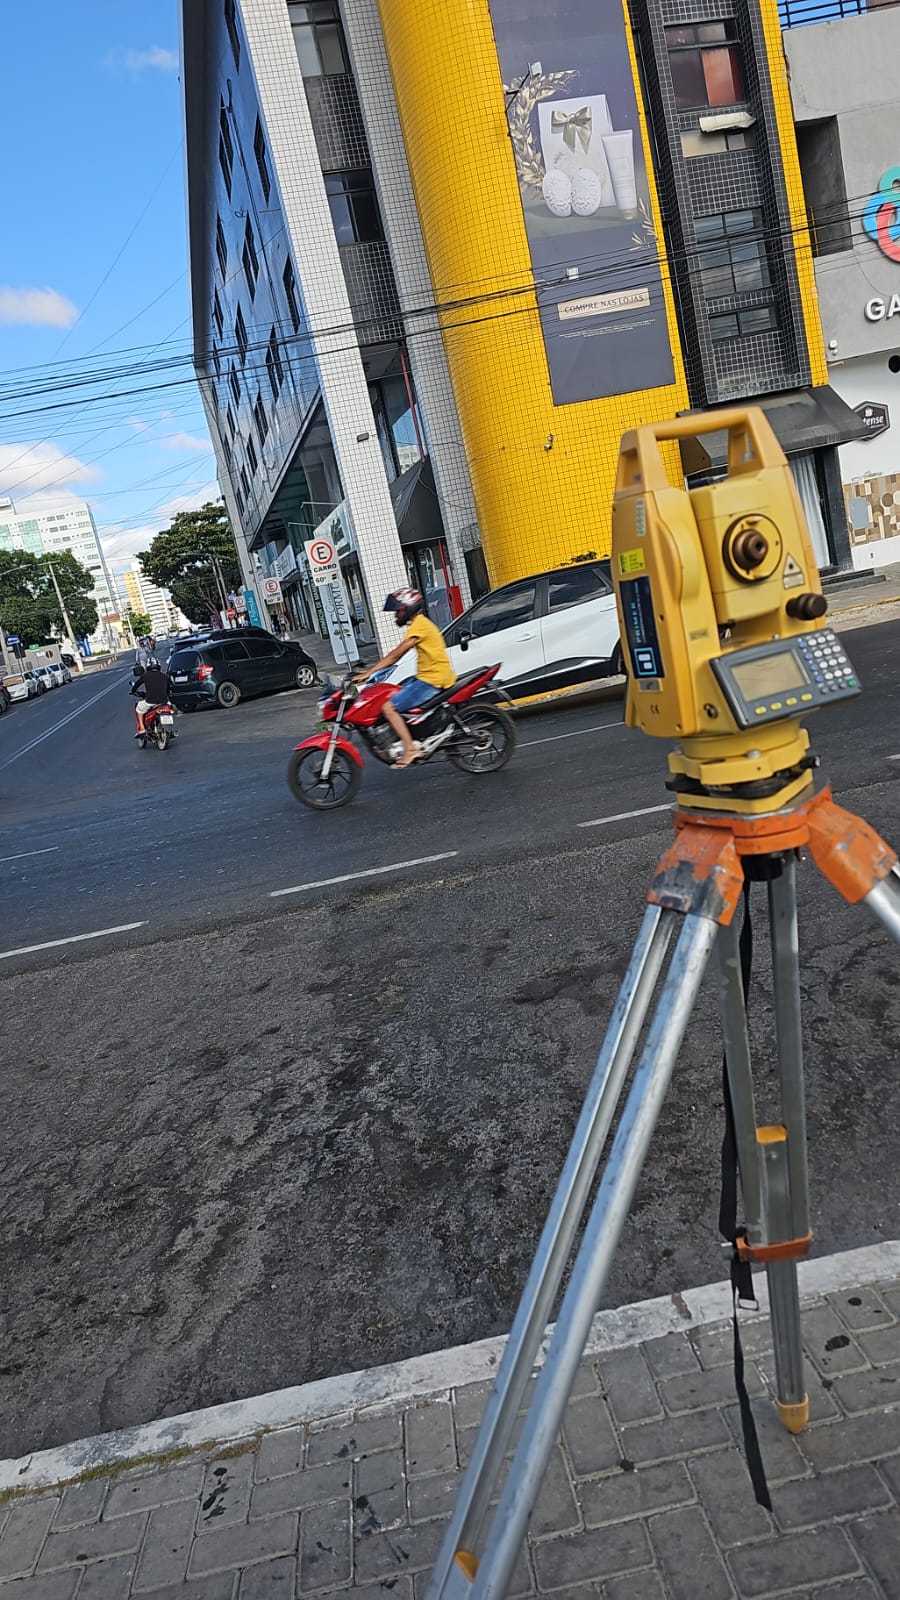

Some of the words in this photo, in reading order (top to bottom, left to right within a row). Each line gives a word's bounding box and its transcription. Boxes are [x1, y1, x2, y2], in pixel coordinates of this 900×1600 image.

[564, 302, 598, 313] COMPRE
[600, 298, 617, 308] NAS
[619, 294, 645, 305] LOJAS
[866, 294, 900, 320] GA
[863, 415, 884, 426] tense
[316, 546, 328, 560] E
[313, 563, 337, 573] CARRO
[631, 602, 642, 643] PRIMER
